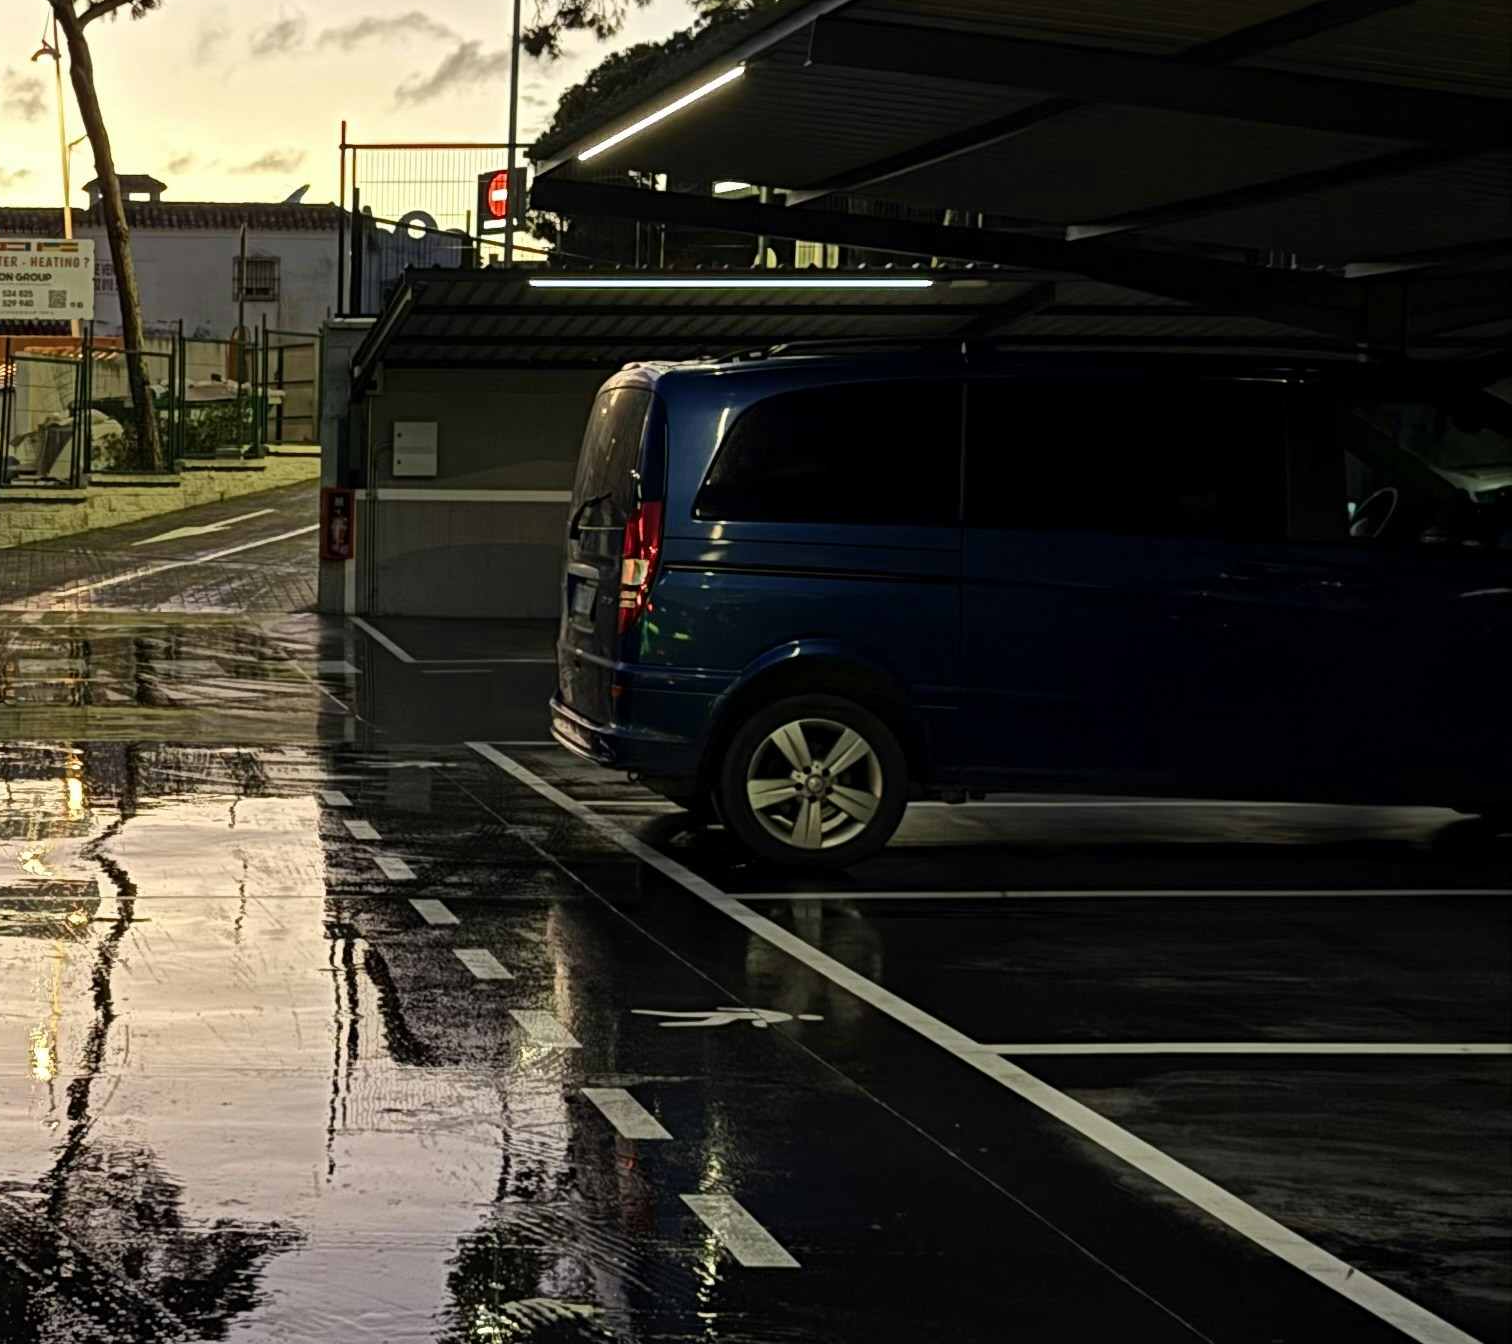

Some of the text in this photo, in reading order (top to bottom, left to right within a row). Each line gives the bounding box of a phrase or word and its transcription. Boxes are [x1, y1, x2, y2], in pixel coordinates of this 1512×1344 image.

[30, 257, 80, 268] HEATING
[84, 257, 89, 268] ?
[15, 272, 52, 282] GROUP
